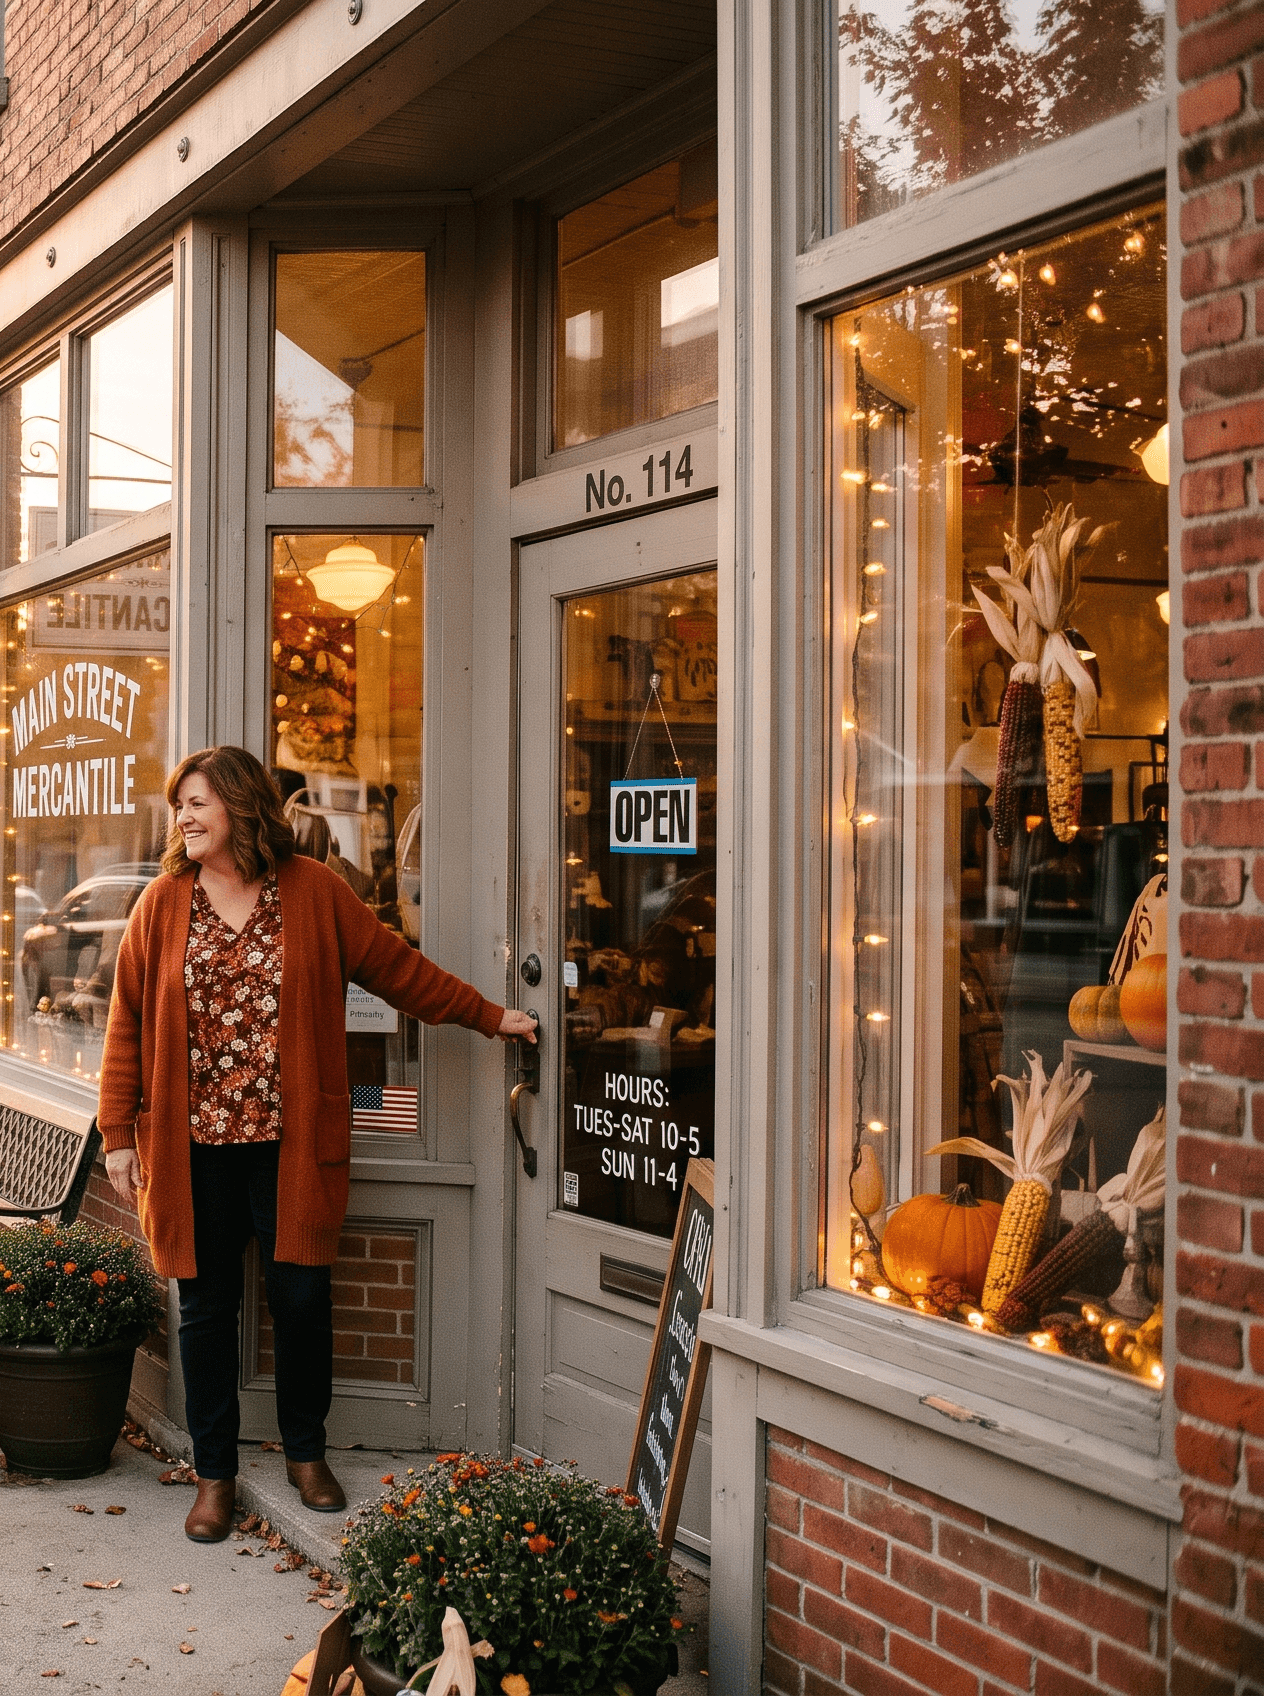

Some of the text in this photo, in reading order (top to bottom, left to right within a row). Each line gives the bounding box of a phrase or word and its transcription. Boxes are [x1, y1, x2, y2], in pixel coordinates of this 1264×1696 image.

[585, 444, 694, 513] No. 114
[11, 661, 141, 756] MAIN STREET
[12, 754, 137, 818] MERCANTILE
[615, 789, 690, 844] OPEN
[605, 1072, 670, 1107] HOURS:
[573, 1104, 700, 1156] TUES-SAT 10-5
[601, 1148, 678, 1191] SUN 11-4
